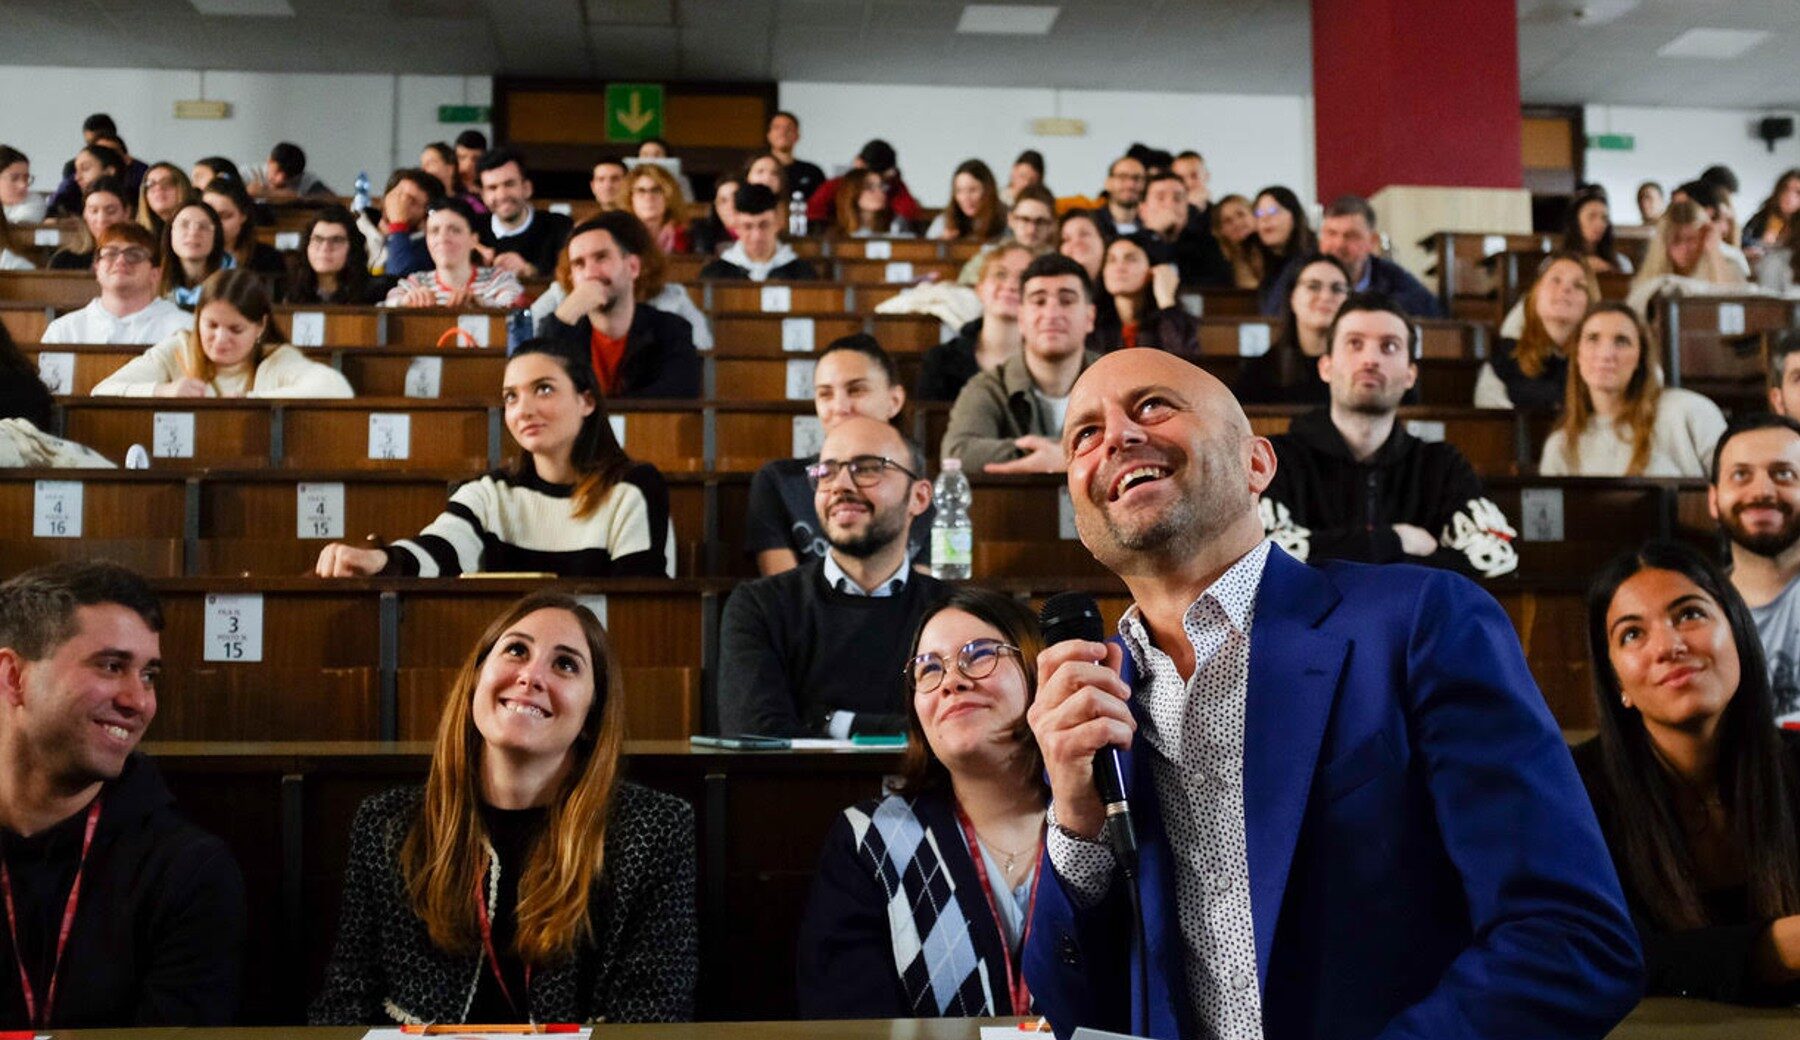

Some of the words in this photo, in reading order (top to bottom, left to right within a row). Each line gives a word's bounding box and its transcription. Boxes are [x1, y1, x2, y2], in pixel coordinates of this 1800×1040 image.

[53, 500, 62, 513] 4
[316, 502, 325, 515] 4
[51, 520, 66, 535] 16
[313, 522, 329, 536] 15
[228, 616, 239, 633] 3
[223, 641, 244, 659] 15
